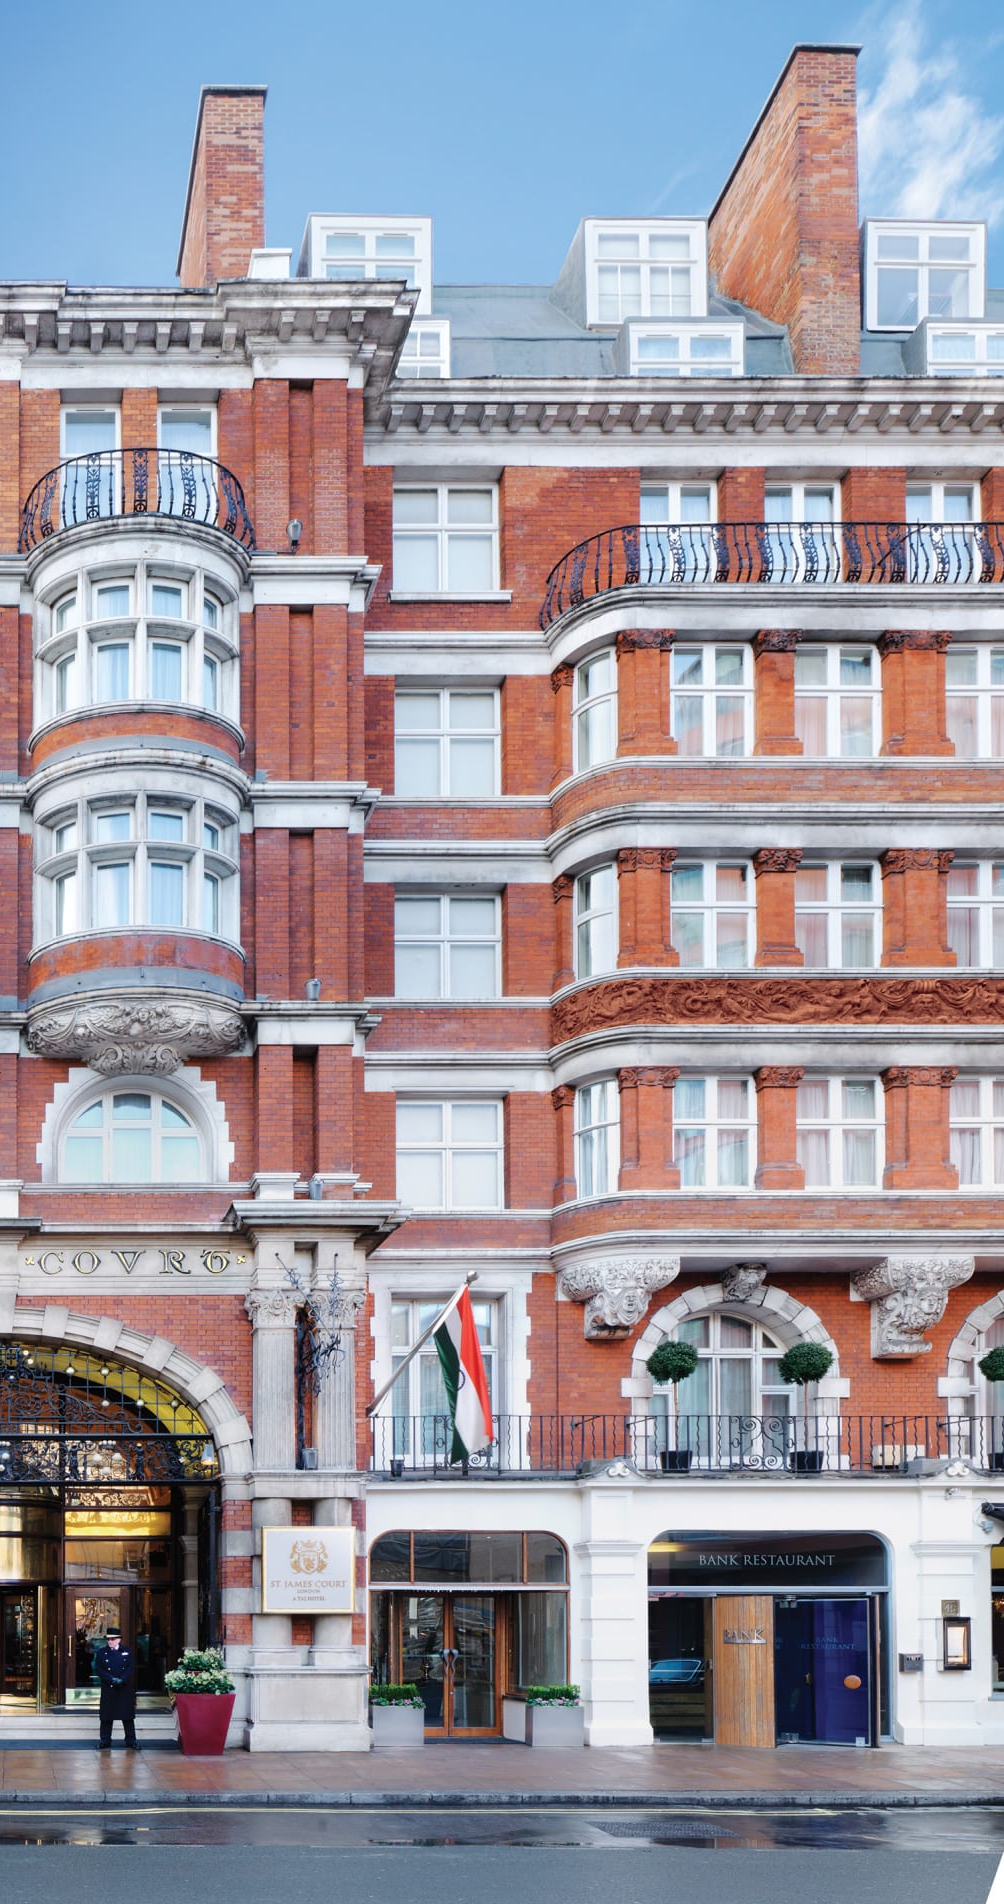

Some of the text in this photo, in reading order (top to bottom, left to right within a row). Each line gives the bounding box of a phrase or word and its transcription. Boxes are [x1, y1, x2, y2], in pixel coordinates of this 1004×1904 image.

[699, 1554, 836, 1566] BANK RESTAURANT
[284, 1580, 313, 1590] JAMES
[314, 1580, 348, 1589] COURT
[723, 1627, 765, 1641] BANK
